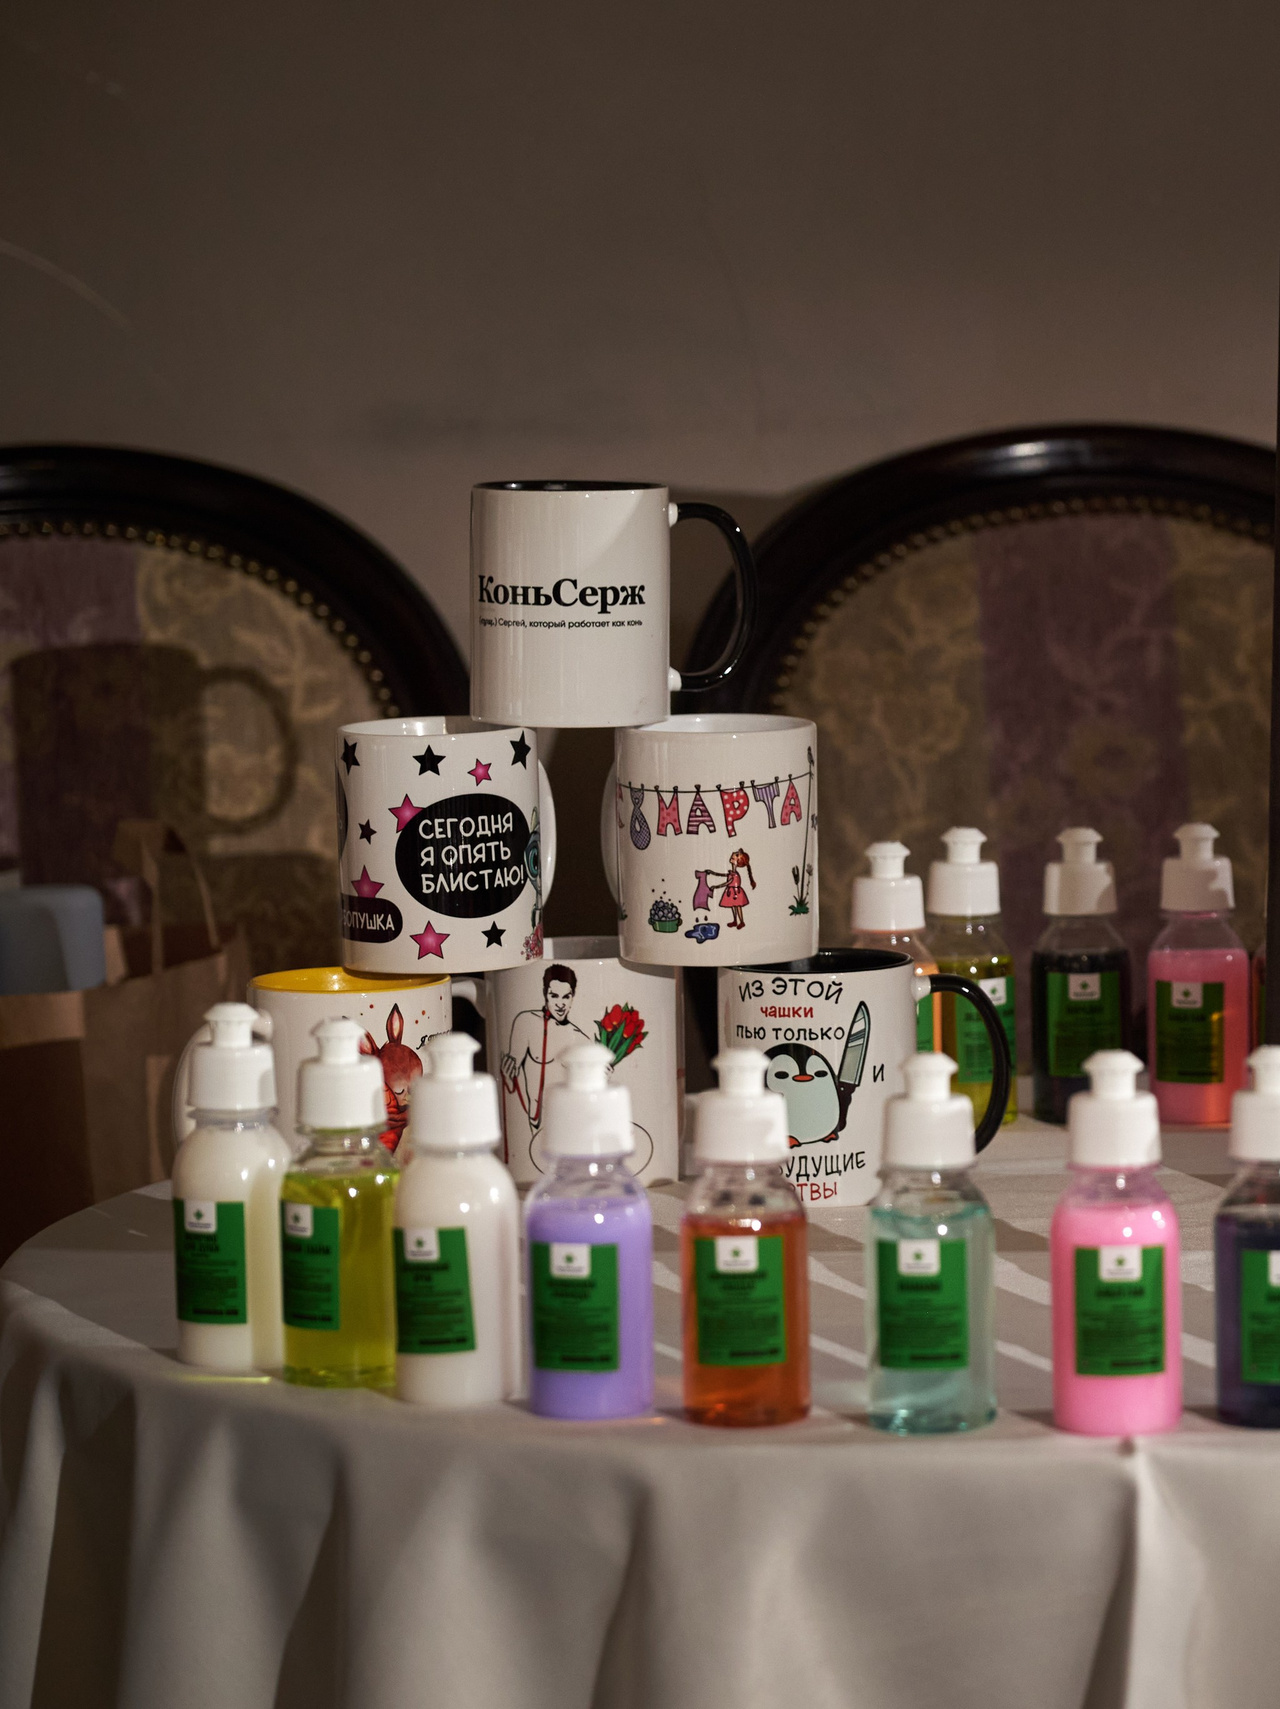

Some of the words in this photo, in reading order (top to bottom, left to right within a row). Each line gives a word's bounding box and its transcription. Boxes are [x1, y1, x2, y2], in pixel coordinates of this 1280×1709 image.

[478, 574, 646, 614] КоньСерж
[498, 617, 527, 628] Сергей,
[529, 619, 566, 630] который
[568, 618, 610, 630] работает
[612, 619, 625, 628] как
[627, 619, 643, 628] конь
[418, 811, 513, 840] СЕГОДНЯ
[630, 786, 651, 850] 8
[655, 780, 803, 838] МАРТА
[420, 846, 435, 867] Я
[441, 840, 511, 866] ОПЯТЬ
[420, 864, 525, 894] БЛИСТАЮ!
[738, 979, 765, 1002] ИЗ
[771, 976, 844, 1005] ЭТОЙ
[760, 1005, 814, 1019] чашки
[779, 1150, 866, 1182] УДУЩИЕ
